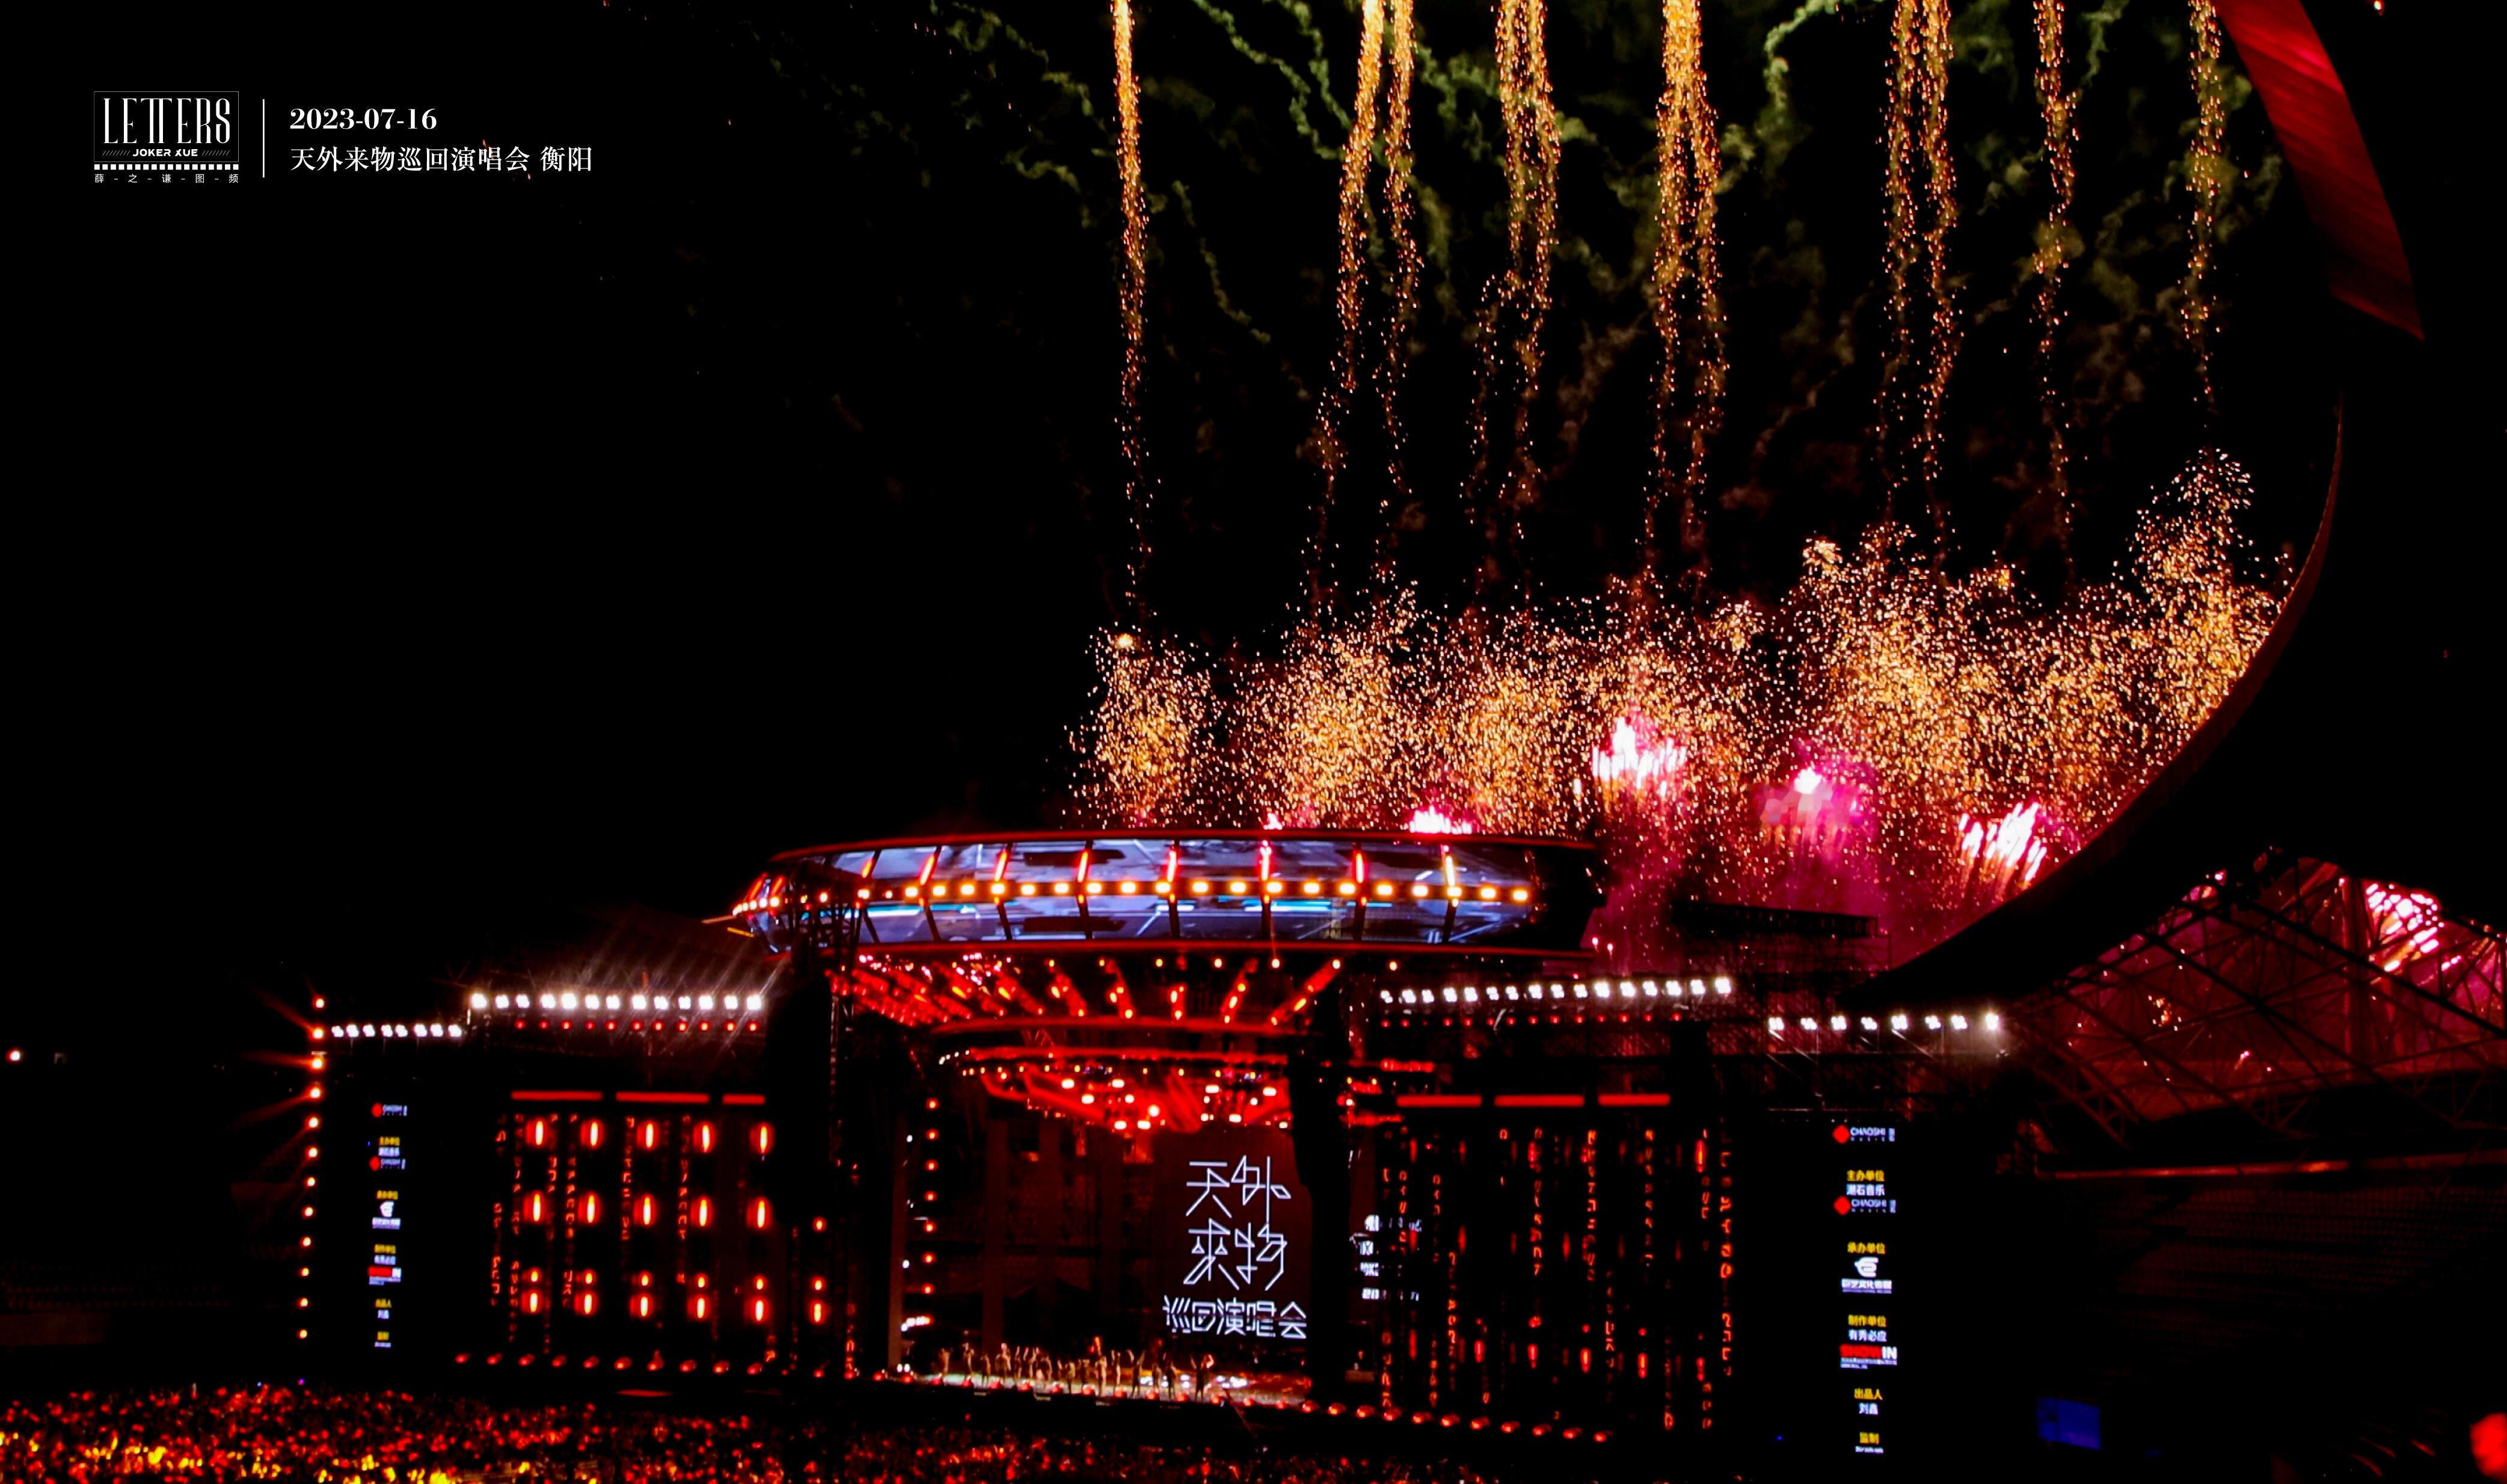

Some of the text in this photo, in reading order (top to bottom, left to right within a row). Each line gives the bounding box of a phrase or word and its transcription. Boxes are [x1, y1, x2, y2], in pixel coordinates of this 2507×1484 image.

[1163, 1295, 1307, 1339] 巡回演唱会
